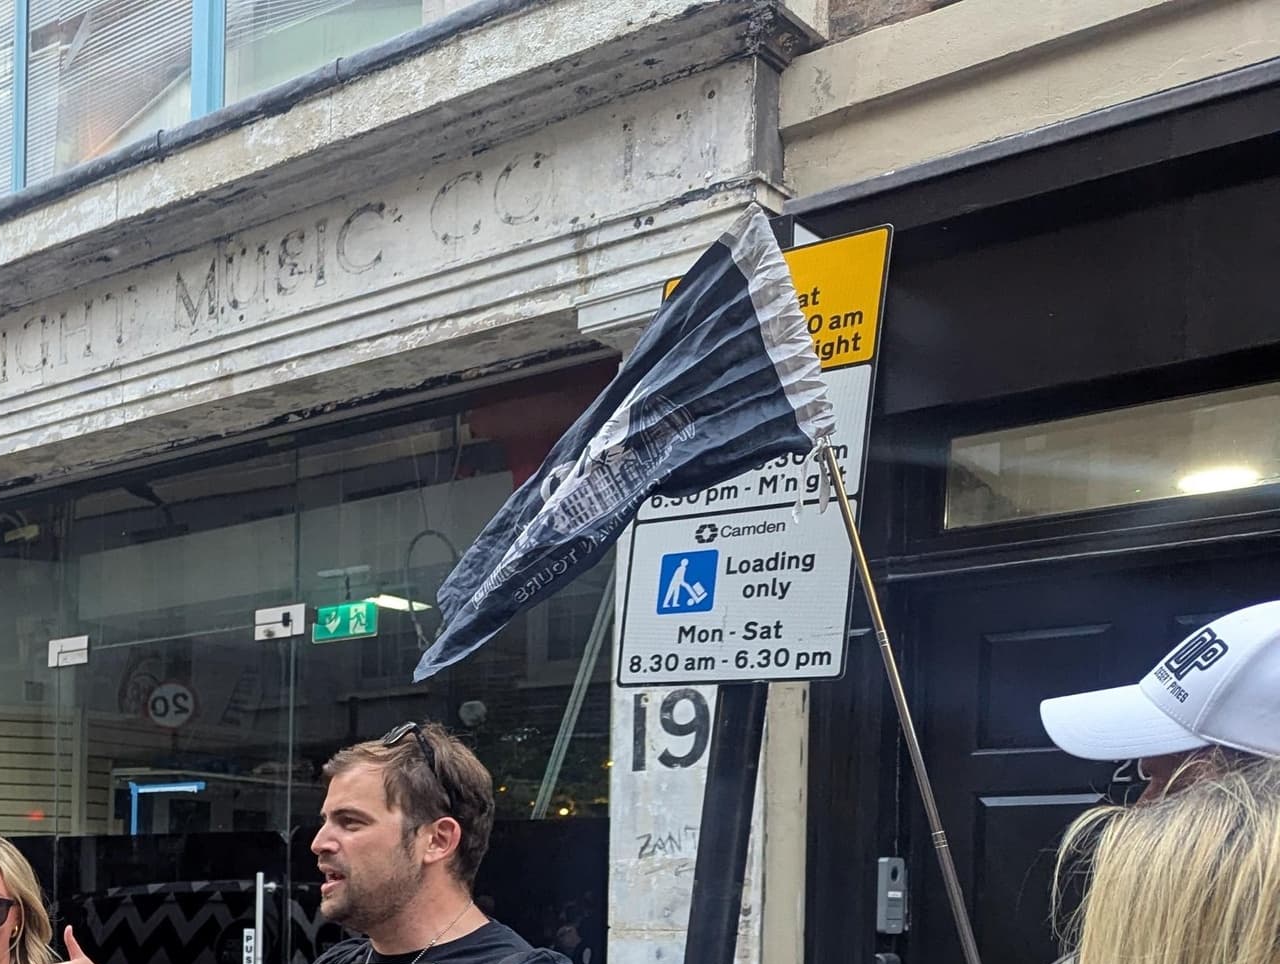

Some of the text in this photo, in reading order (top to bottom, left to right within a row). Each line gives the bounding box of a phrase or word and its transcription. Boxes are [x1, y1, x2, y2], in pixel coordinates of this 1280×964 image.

[175, 202, 386, 328] MUSIC
[828, 310, 864, 330] am
[814, 331, 862, 361] ight
[705, 485, 739, 506] pm
[720, 521, 786, 539] Camden
[726, 551, 816, 575] Loading
[742, 578, 792, 600] only
[678, 625, 724, 644] Mon
[742, 620, 783, 641] Sat
[629, 653, 679, 673] 8.30
[684, 655, 715, 671] am
[735, 648, 790, 669] 6.30
[795, 650, 832, 671] pm
[1169, 681, 1190, 704] PINES
[632, 688, 711, 772] 19
